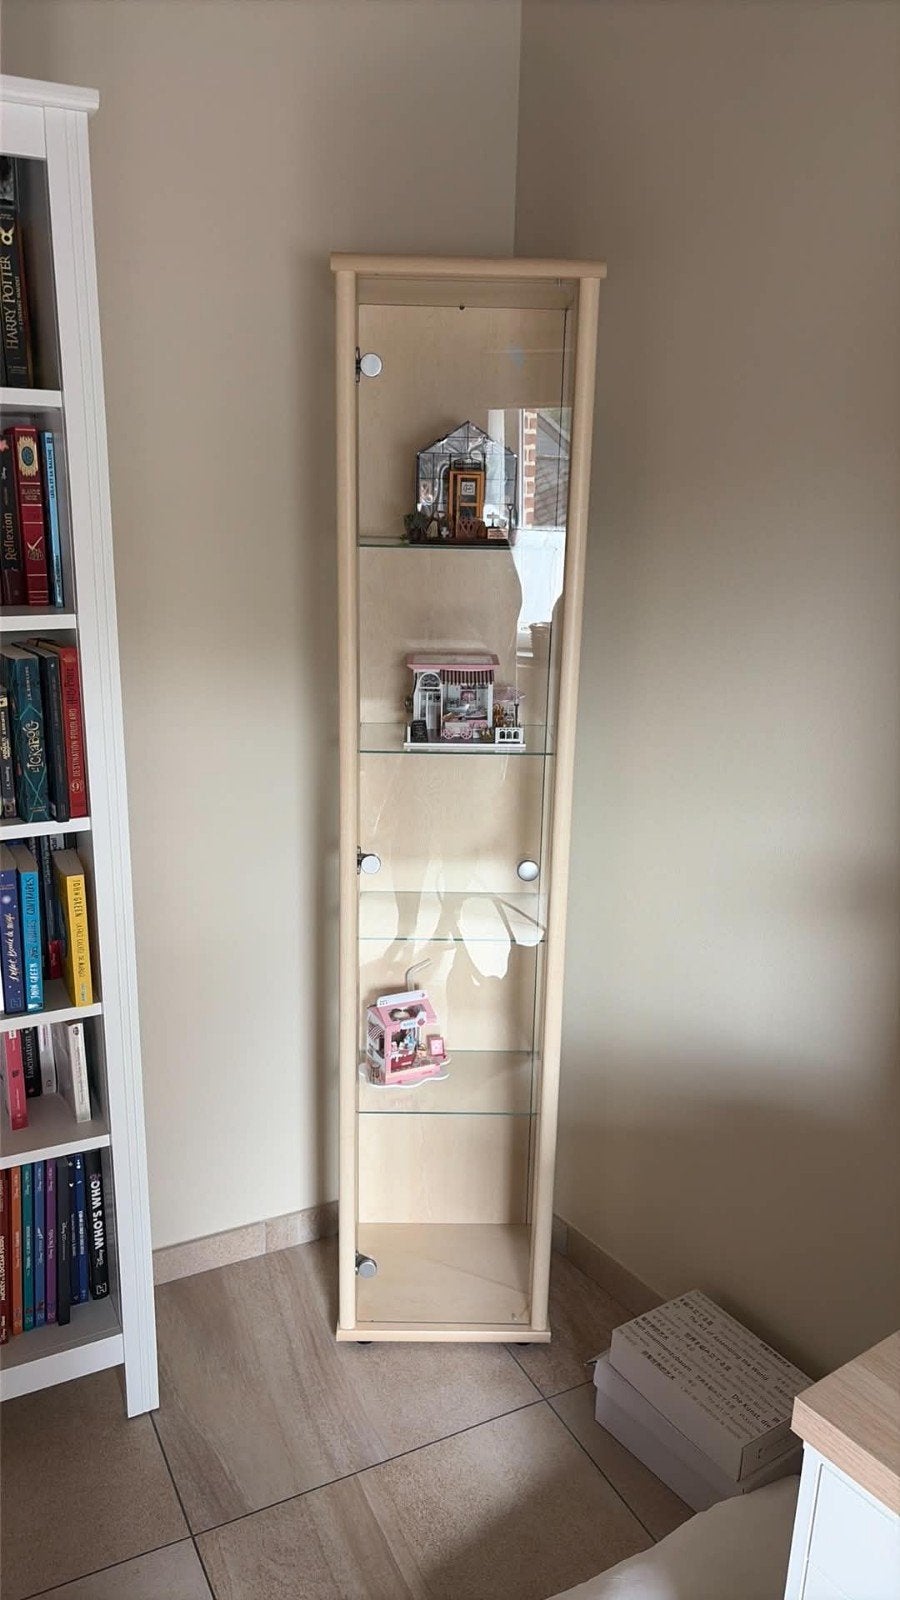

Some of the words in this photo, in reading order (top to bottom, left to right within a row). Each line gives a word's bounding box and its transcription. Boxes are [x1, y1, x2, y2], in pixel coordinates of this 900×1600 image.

[0, 256, 15, 303] POTTER
[4, 304, 19, 349] HARRY
[71, 740, 80, 777] DESTINATION
[90, 1180, 102, 1209] WHO
[92, 1210, 104, 1250] WHO'S
[730, 1392, 744, 1404] Die
